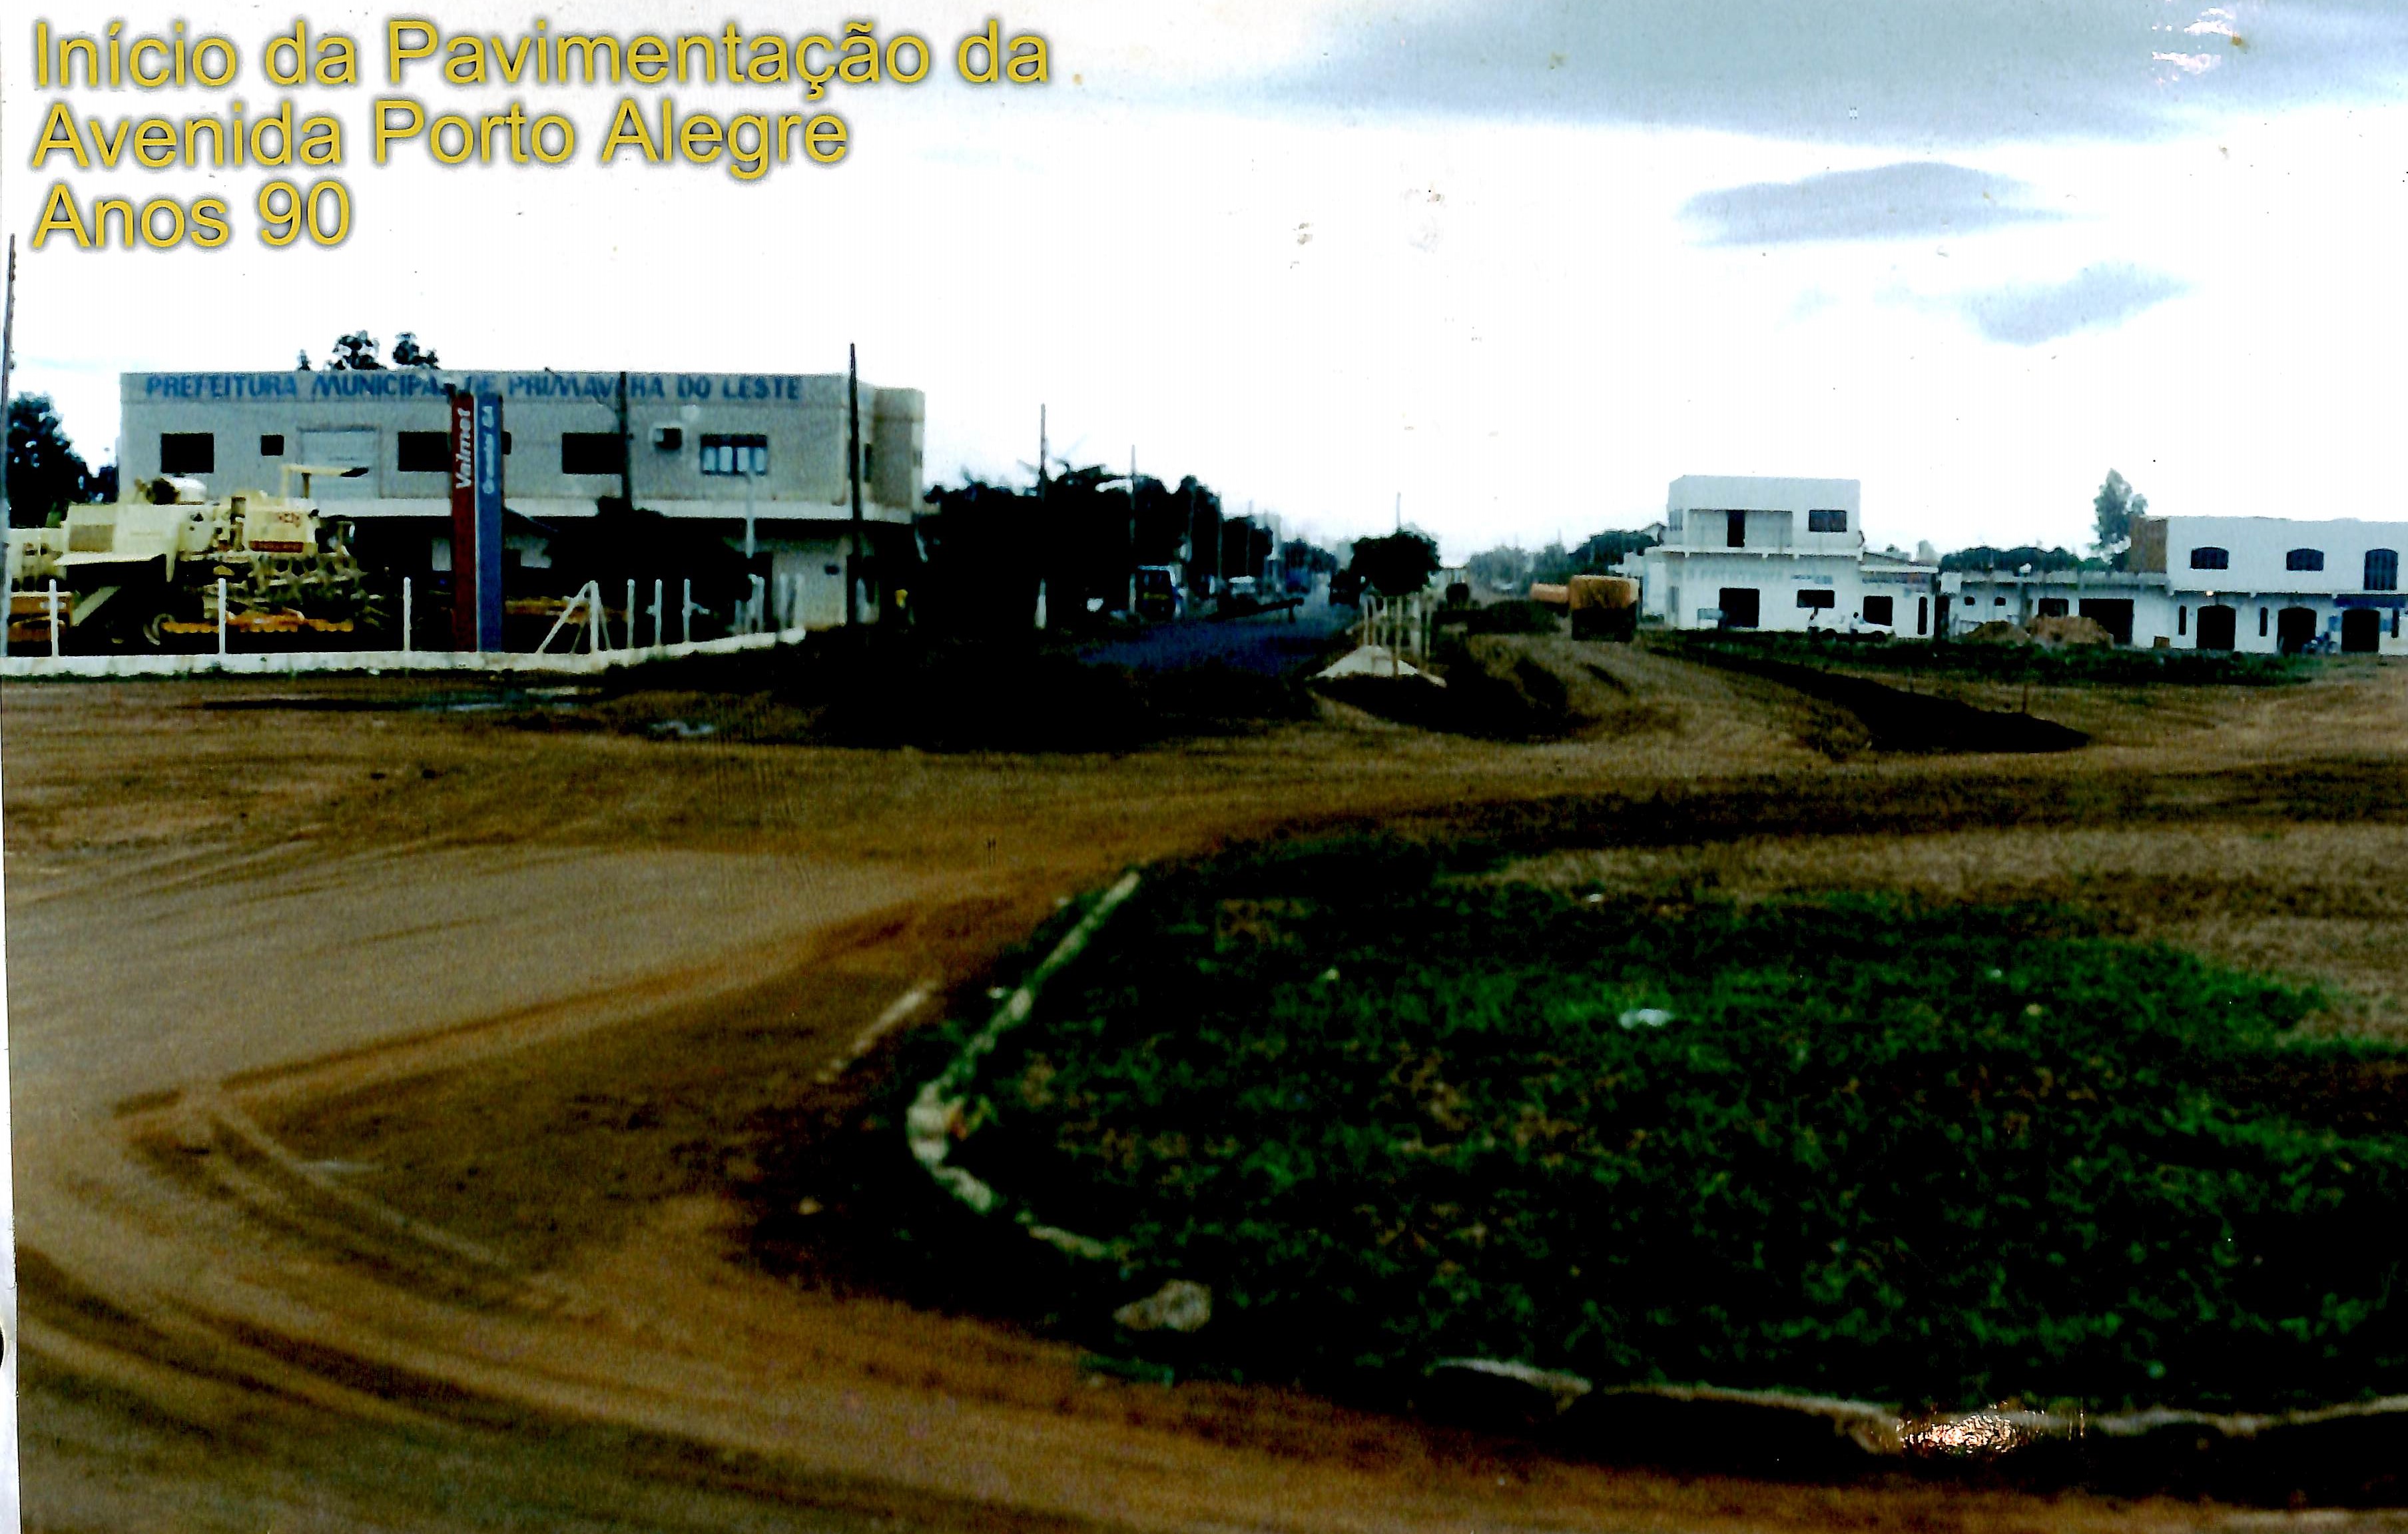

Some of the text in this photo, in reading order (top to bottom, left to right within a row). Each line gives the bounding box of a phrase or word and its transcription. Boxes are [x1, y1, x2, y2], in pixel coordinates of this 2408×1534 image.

[145, 374, 298, 398] PREFEITURA
[677, 375, 711, 399] DO
[723, 376, 799, 400] LESTE
[455, 407, 471, 488] Valmet
